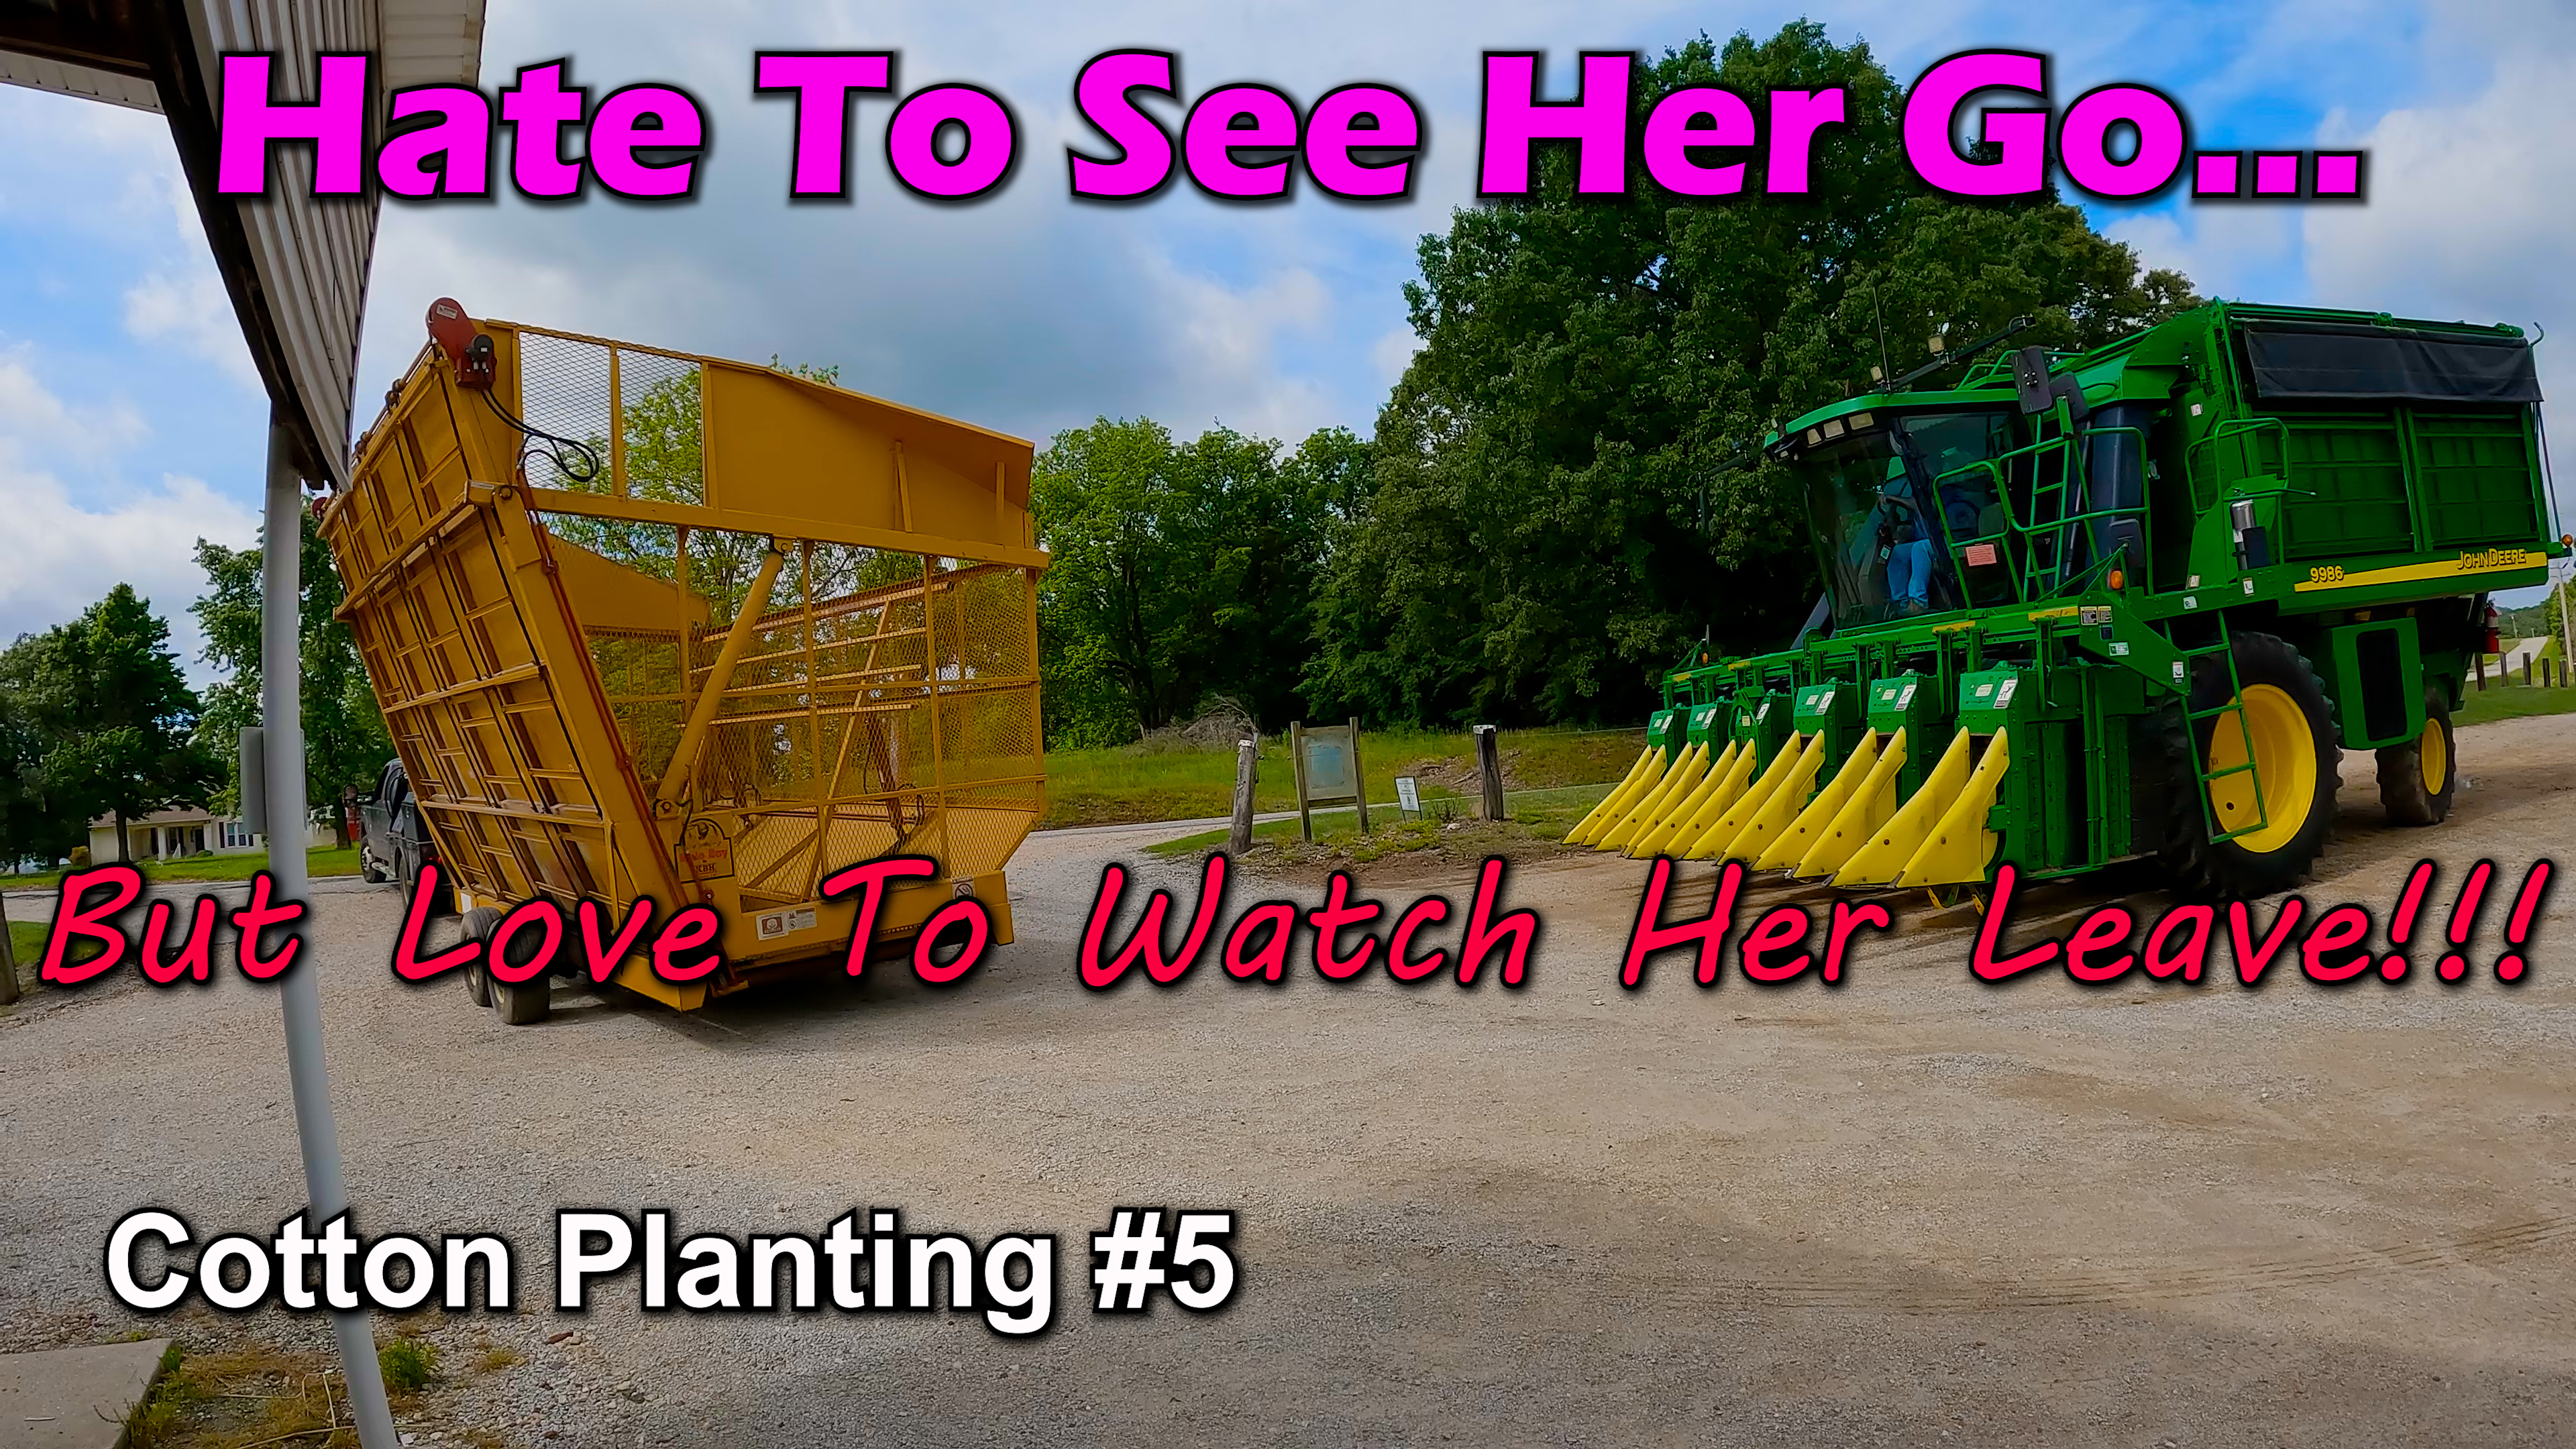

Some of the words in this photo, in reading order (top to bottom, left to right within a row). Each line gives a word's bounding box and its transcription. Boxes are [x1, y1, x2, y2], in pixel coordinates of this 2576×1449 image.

[2457, 550, 2489, 570] JOHN
[2488, 547, 2526, 566] DEERE
[2310, 566, 2344, 583] 9986
